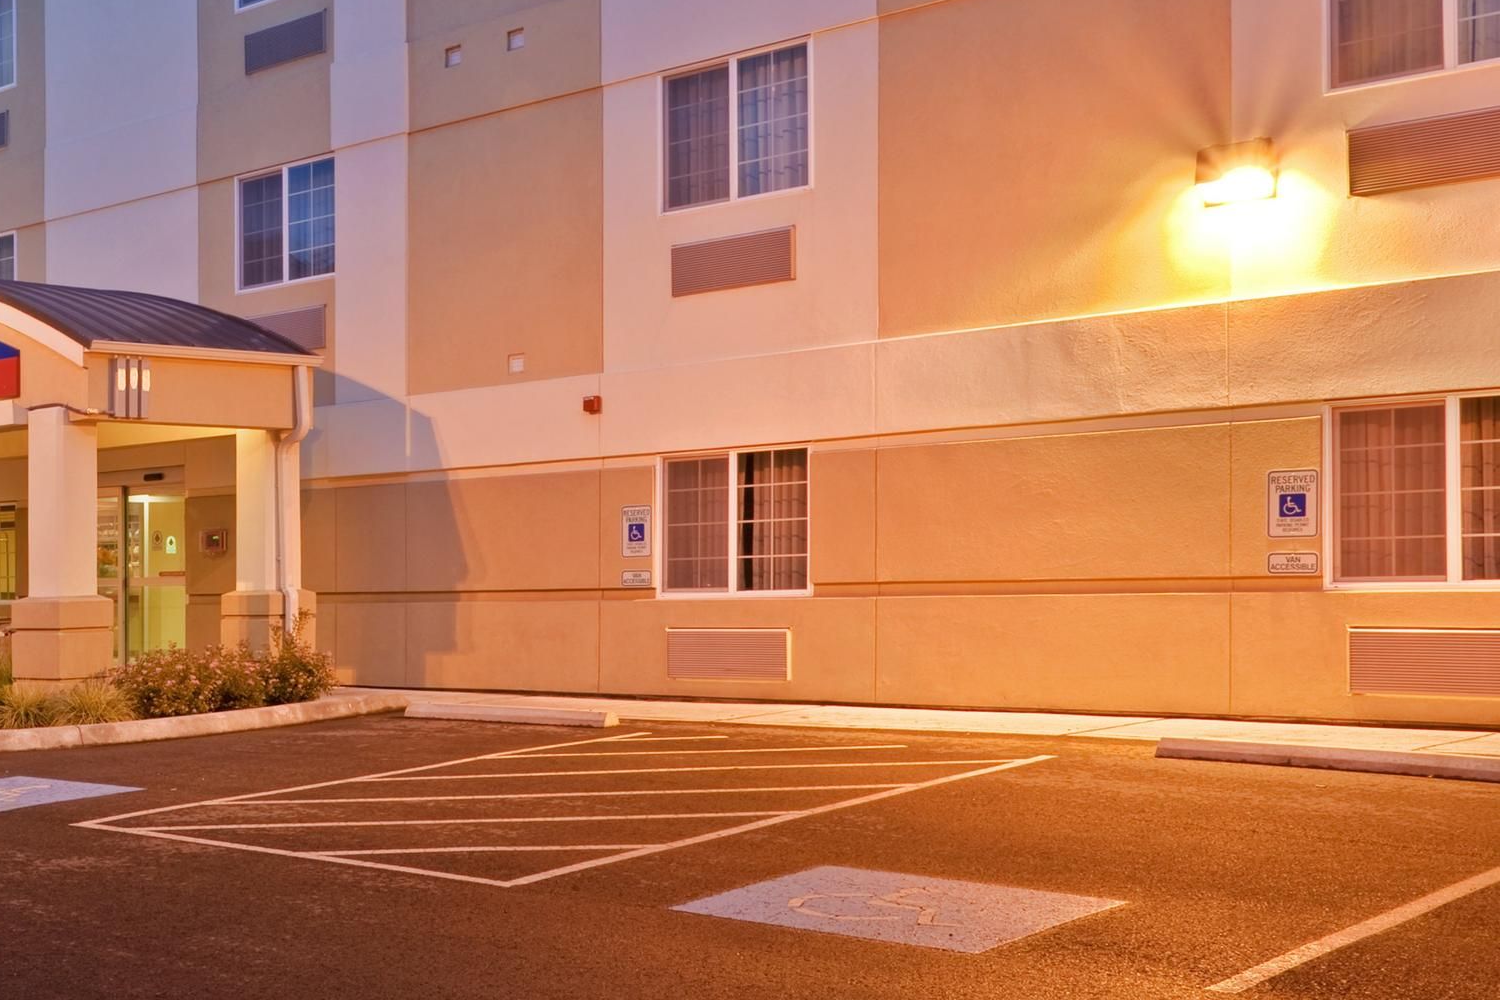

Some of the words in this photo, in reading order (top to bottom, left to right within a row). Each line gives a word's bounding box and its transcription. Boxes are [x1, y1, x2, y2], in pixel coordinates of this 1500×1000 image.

[1270, 475, 1315, 485] RESERVED
[1275, 484, 1311, 493] PARKING
[1270, 563, 1316, 571] ACCESSIBLE
